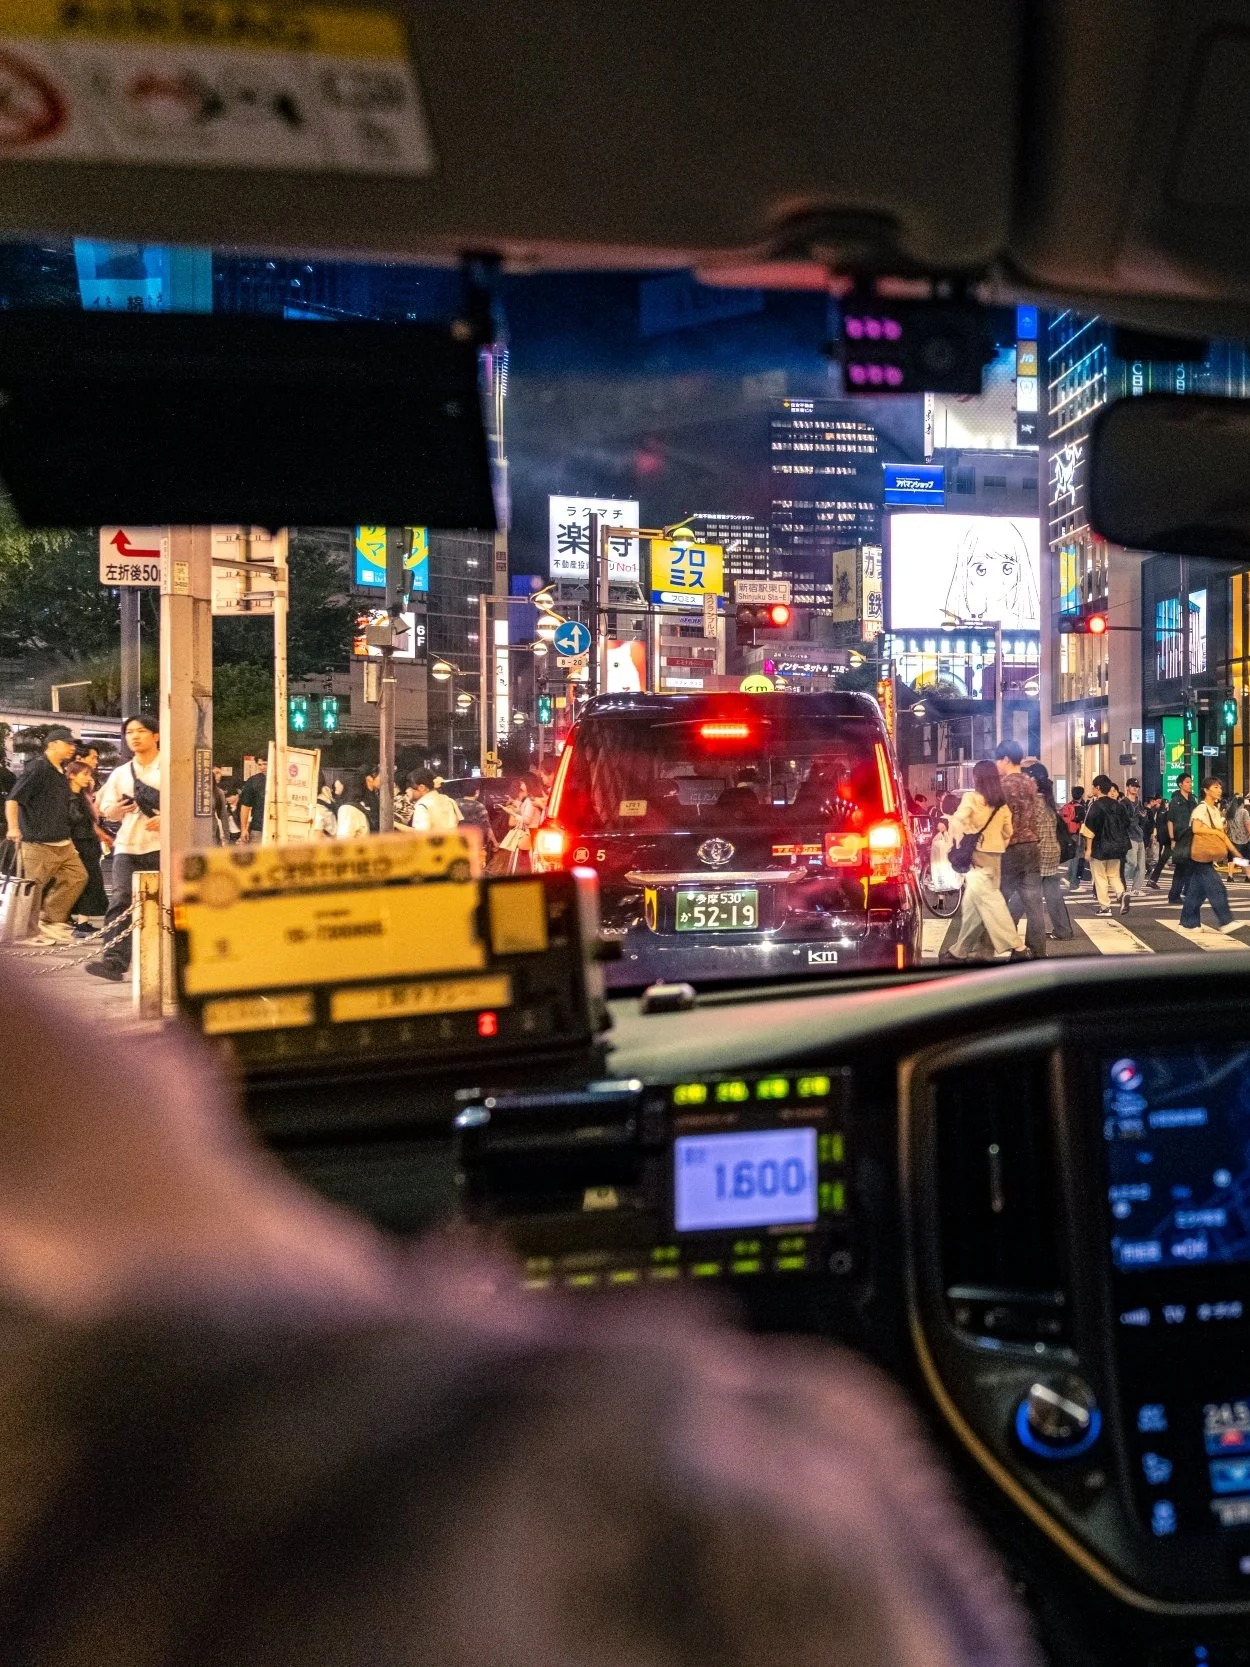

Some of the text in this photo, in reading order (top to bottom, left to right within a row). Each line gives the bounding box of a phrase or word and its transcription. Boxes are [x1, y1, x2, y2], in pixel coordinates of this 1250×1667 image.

[566, 506, 623, 519] ラクマチ
[105, 563, 160, 582] 左折後50
[738, 583, 787, 593] 新宿駅東口
[738, 593, 766, 602] Shinjuku
[596, 850, 606, 861] 5
[695, 892, 742, 904] 多摩 530
[680, 905, 755, 927] か 52-19
[808, 950, 838, 962] km
